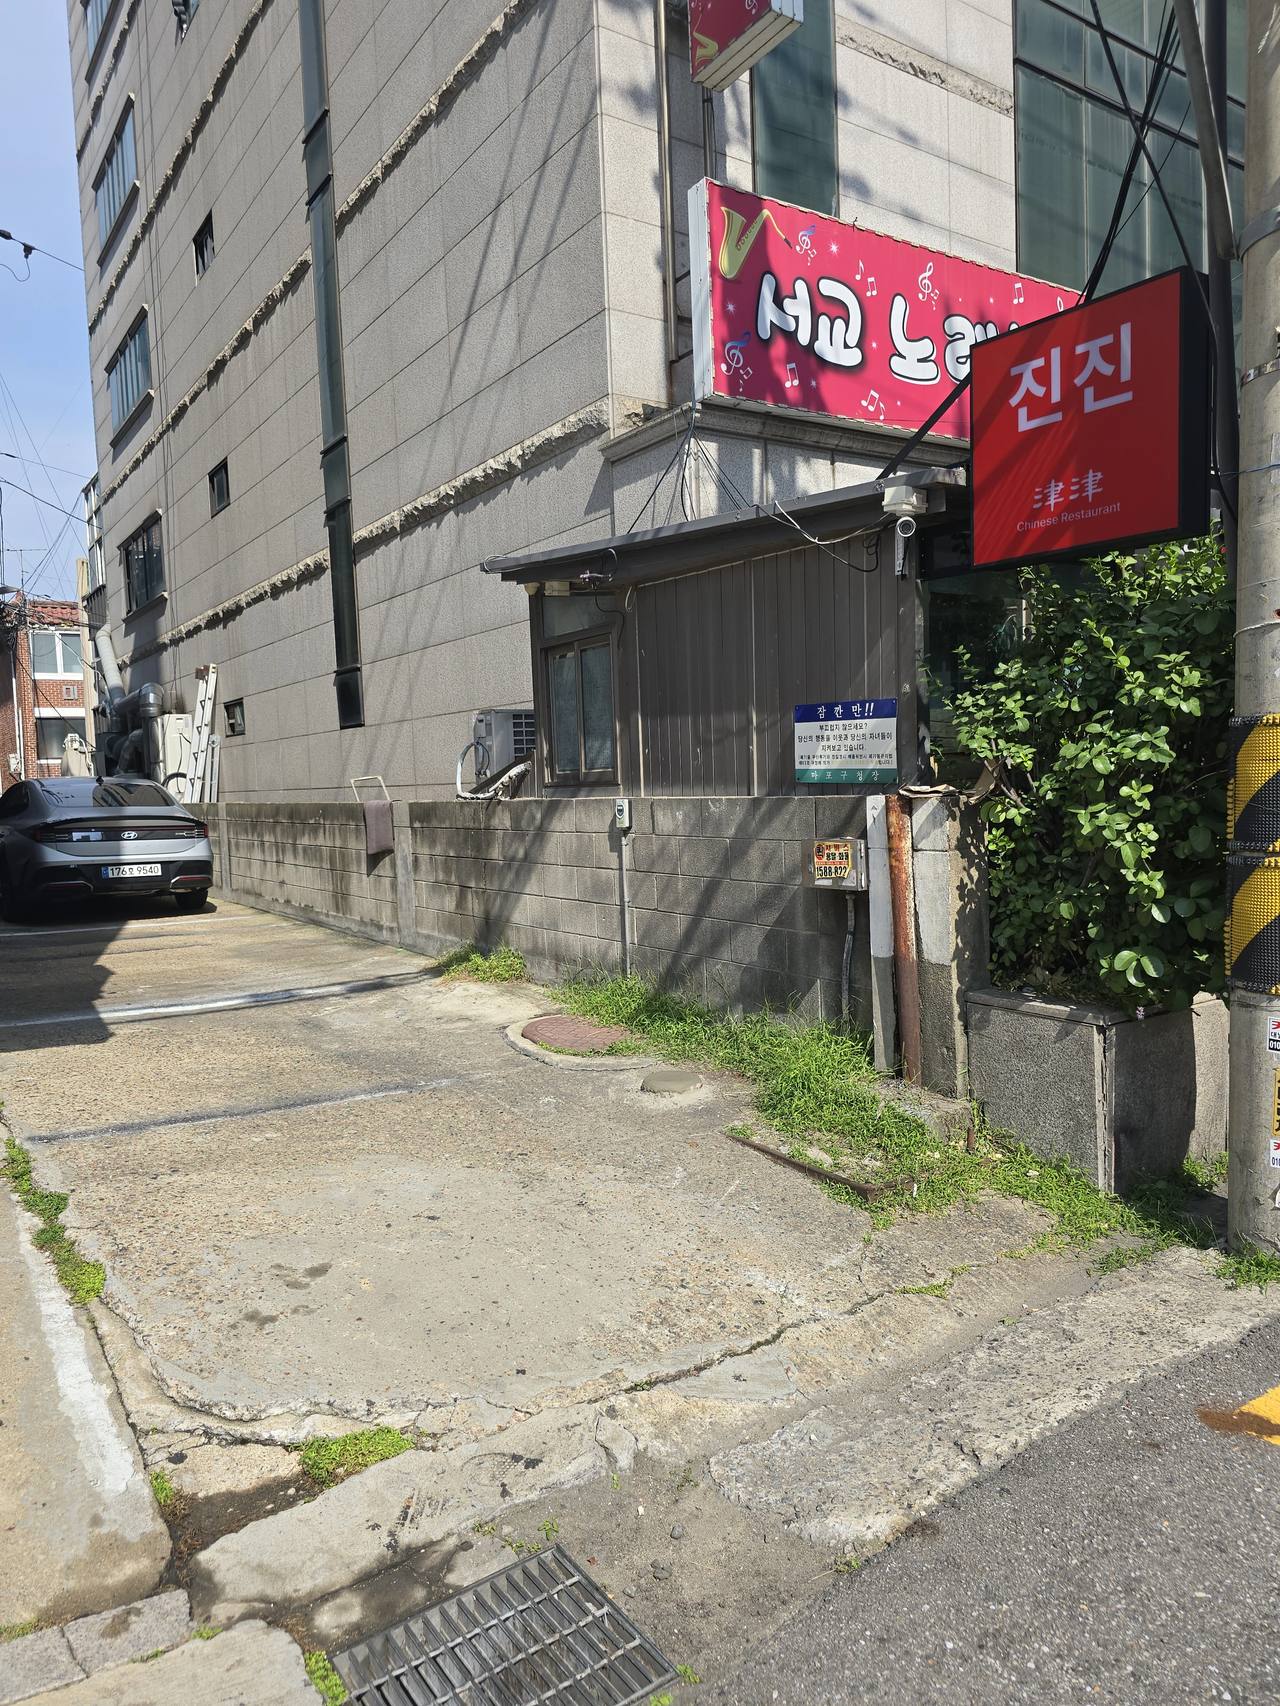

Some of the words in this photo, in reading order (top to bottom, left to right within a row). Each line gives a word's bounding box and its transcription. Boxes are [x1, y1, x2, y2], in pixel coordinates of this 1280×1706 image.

[755, 271, 864, 367] 서교
[1008, 321, 1133, 433] 진진
[1033, 469, 1103, 512] 津津
[1017, 516, 1058, 532] Chinese
[1061, 502, 1121, 523] Restaurant
[798, 735, 813, 743] 당신의
[850, 733, 867, 741] 당신의
[869, 732, 893, 740] 자녀들이
[842, 723, 867, 731] 않으세요?
[137, 865, 159, 874] 9540
